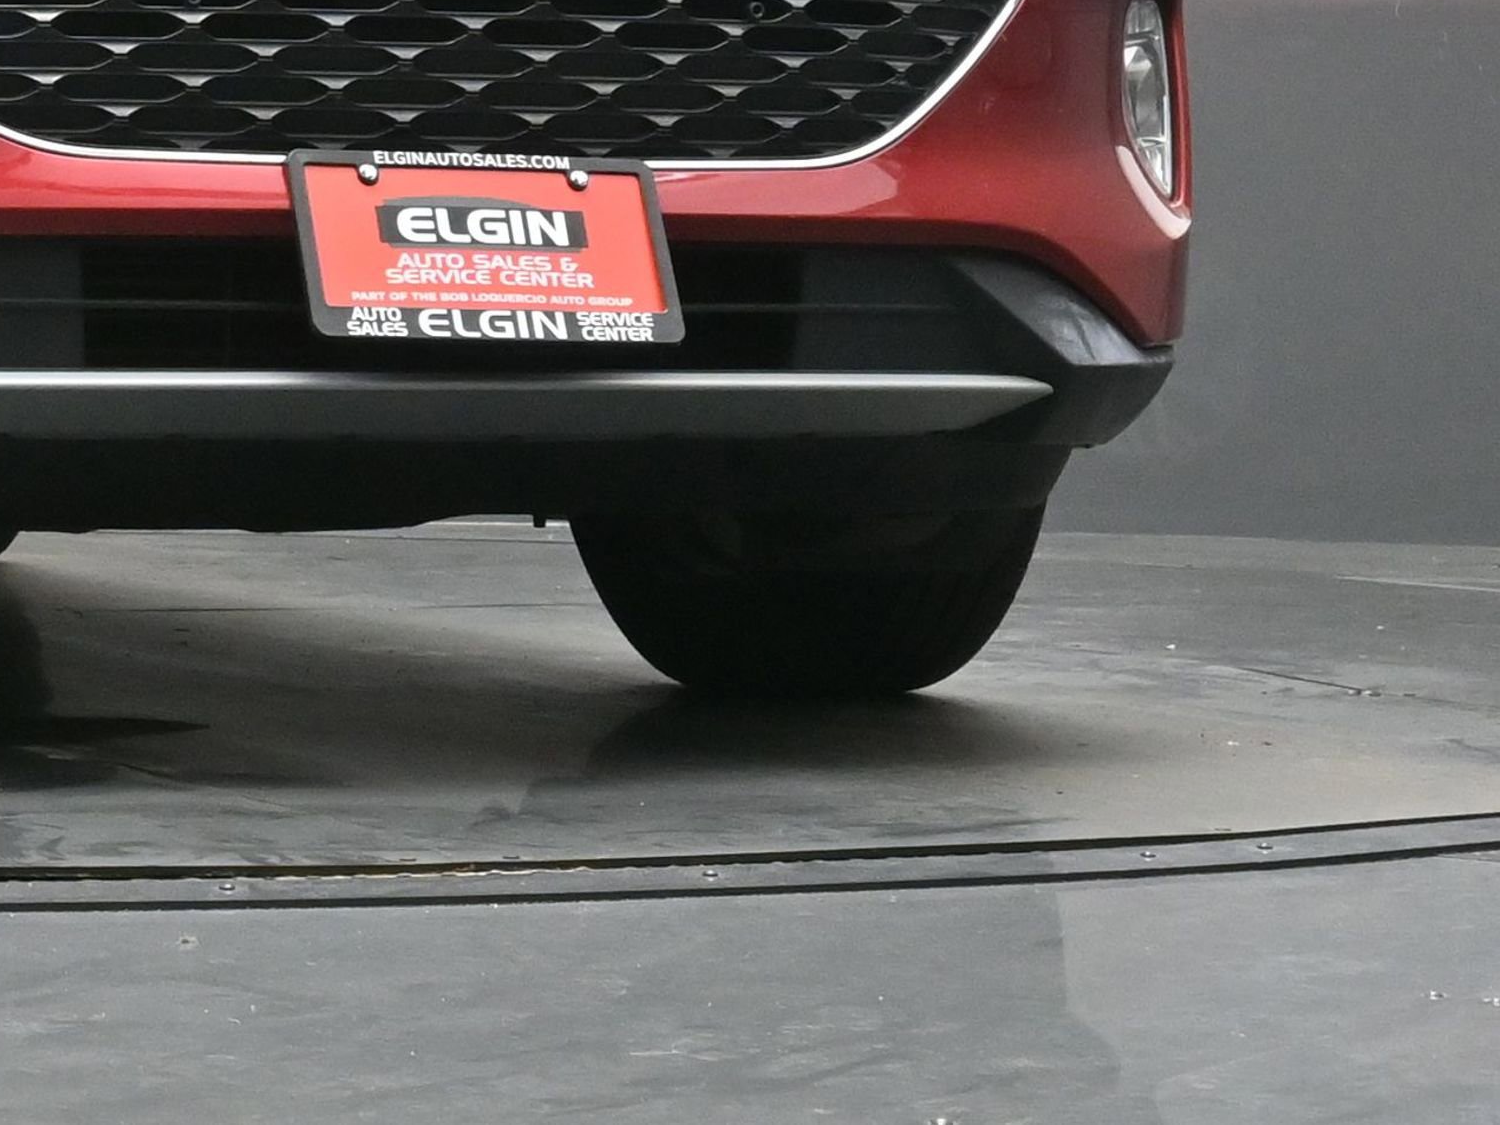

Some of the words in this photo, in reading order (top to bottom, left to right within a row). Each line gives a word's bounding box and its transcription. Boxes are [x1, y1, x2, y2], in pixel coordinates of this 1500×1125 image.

[373, 151, 570, 170] ELGINAUTOSALES.COM
[396, 207, 570, 246] ELGIN
[397, 252, 465, 269] AUTO
[472, 254, 552, 271] SALES
[560, 257, 579, 272] &
[385, 268, 492, 285] SERVICE
[500, 271, 595, 288] CENTER
[351, 291, 386, 301] PART
[389, 292, 408, 301] OF
[411, 292, 438, 302] THE
[440, 293, 469, 302] BOB
[550, 296, 585, 305] AUTO
[588, 297, 633, 306] GROUP
[351, 306, 402, 322] AUTO
[576, 312, 655, 327] SERVICE
[346, 321, 409, 337] SALES
[418, 308, 568, 340] ELGIN
[581, 326, 654, 342] CENTER
